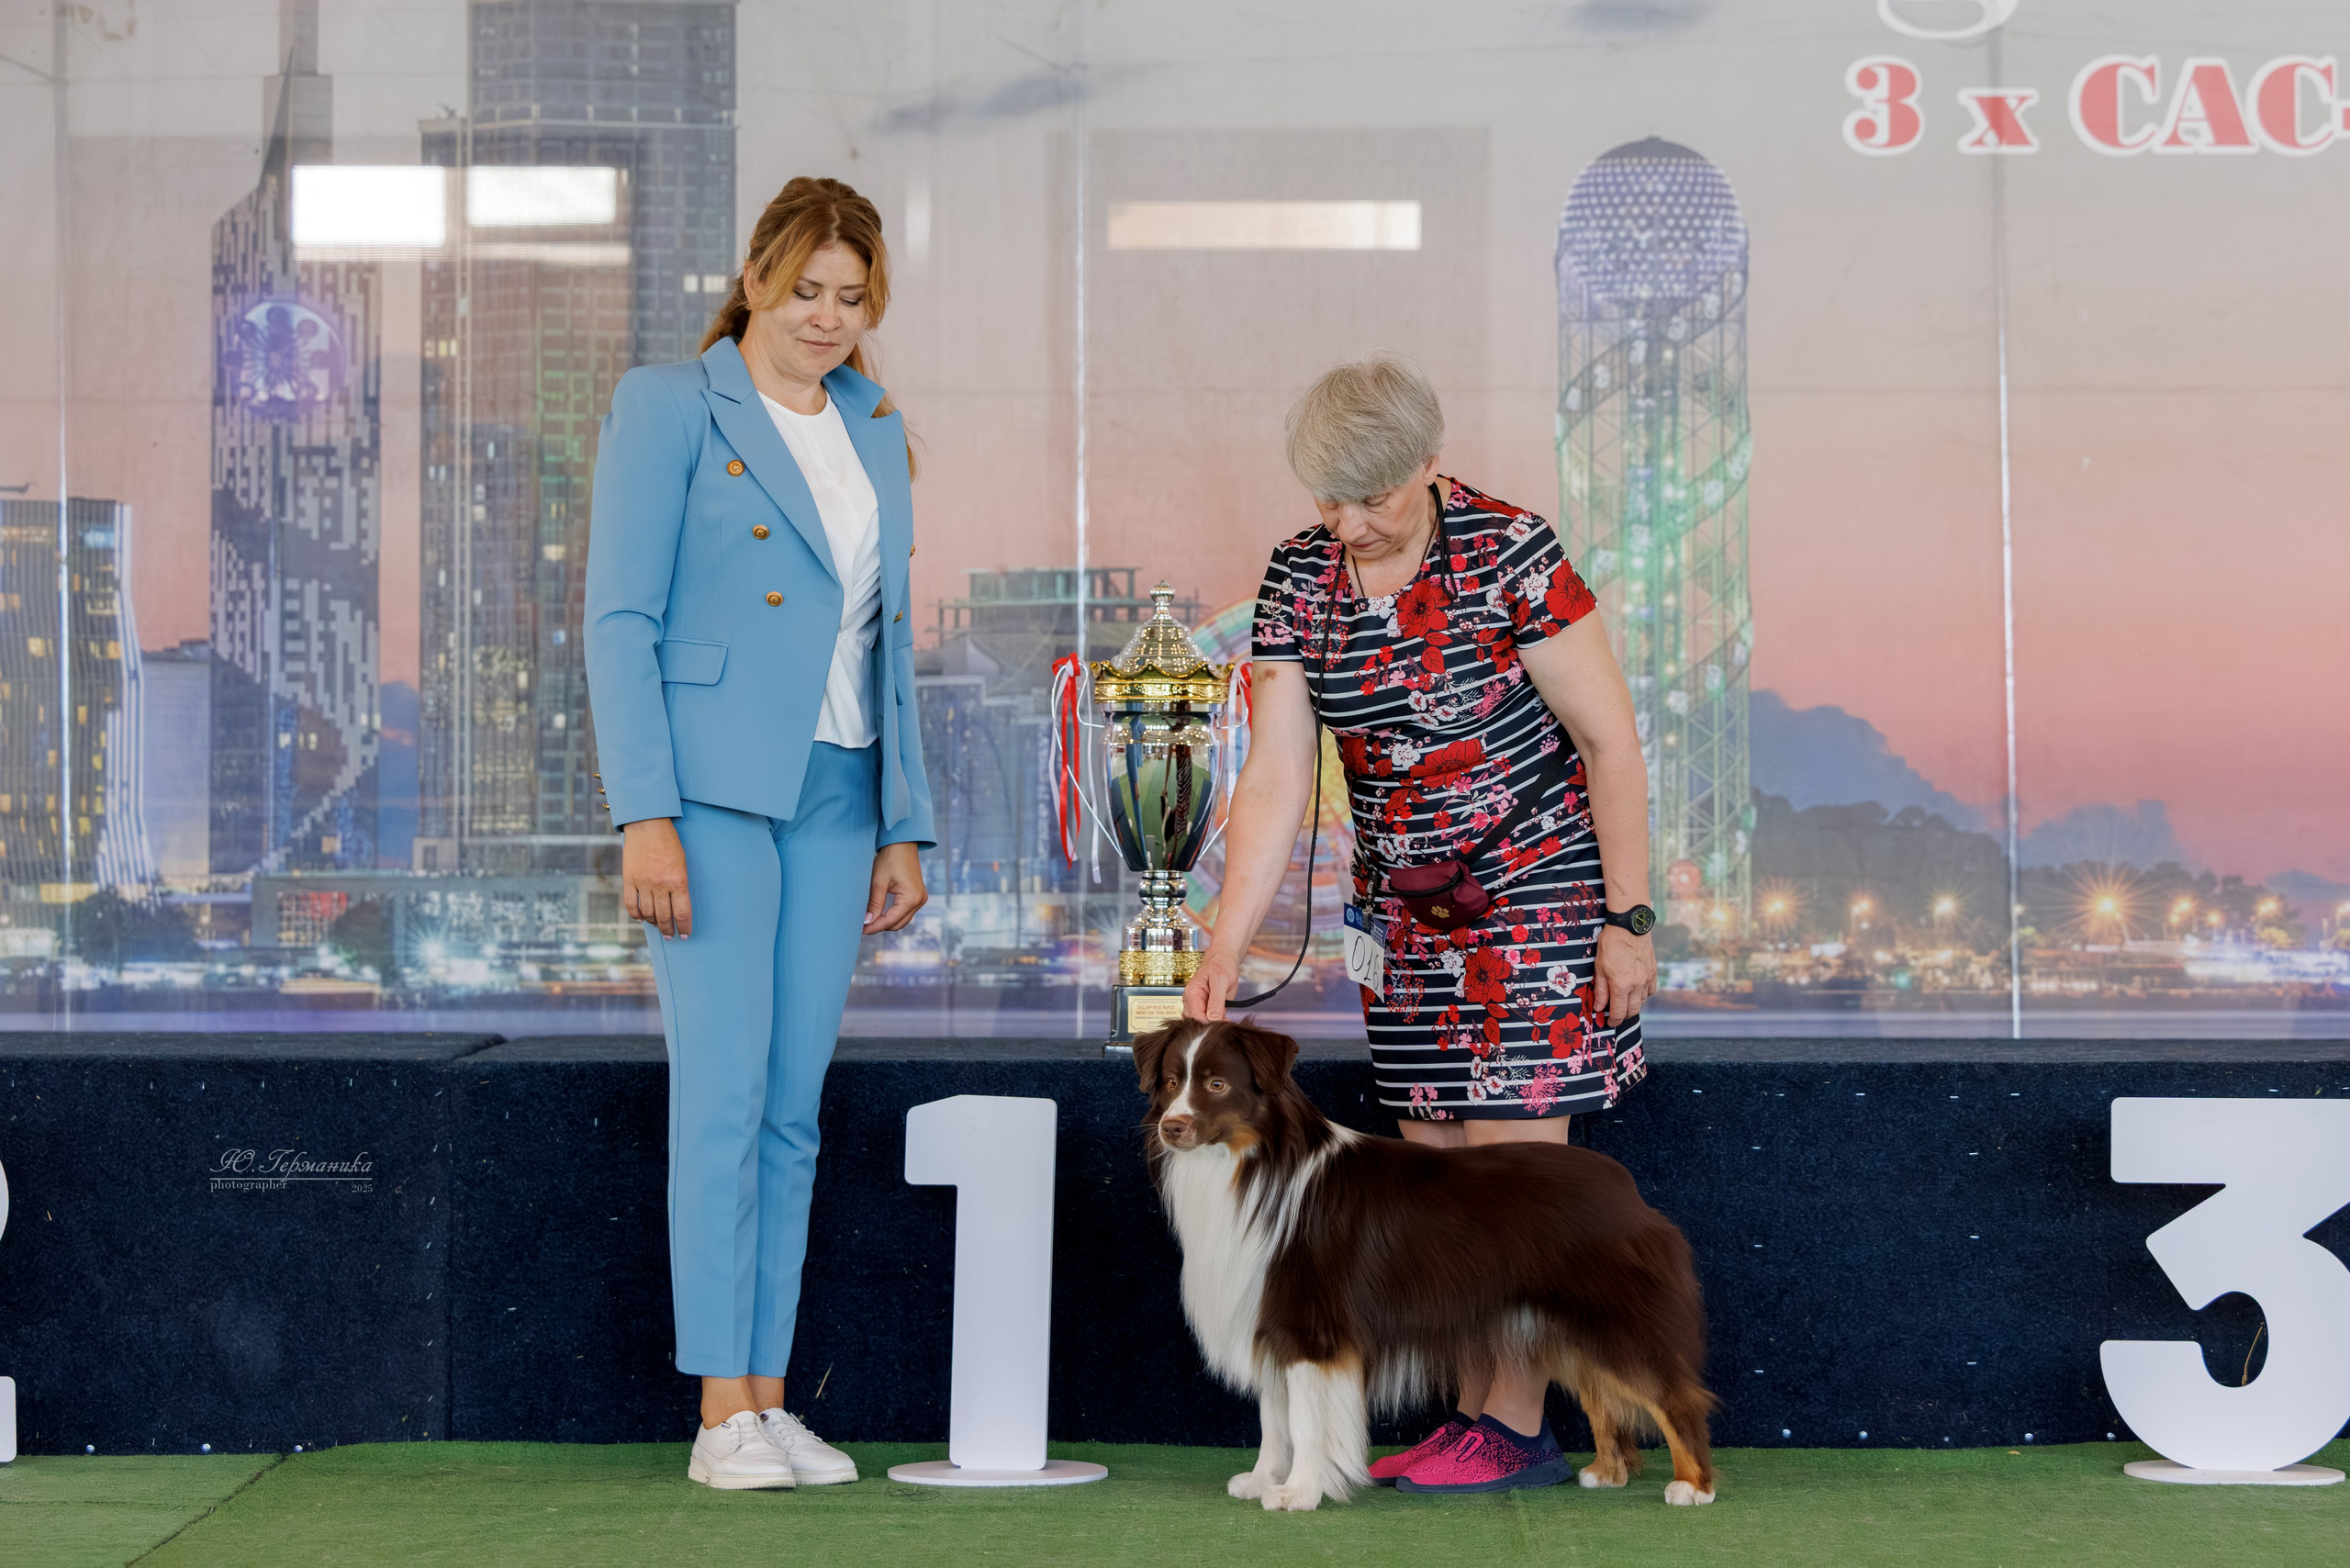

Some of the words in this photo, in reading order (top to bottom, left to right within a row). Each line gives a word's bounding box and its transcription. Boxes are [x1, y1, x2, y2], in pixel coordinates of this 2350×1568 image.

[1842, 55, 1924, 156] 3
[1957, 87, 2040, 155] x
[2068, 54, 2350, 157] CAC
[904, 1094, 1058, 1470] 1
[2099, 1097, 2350, 1471] 3
